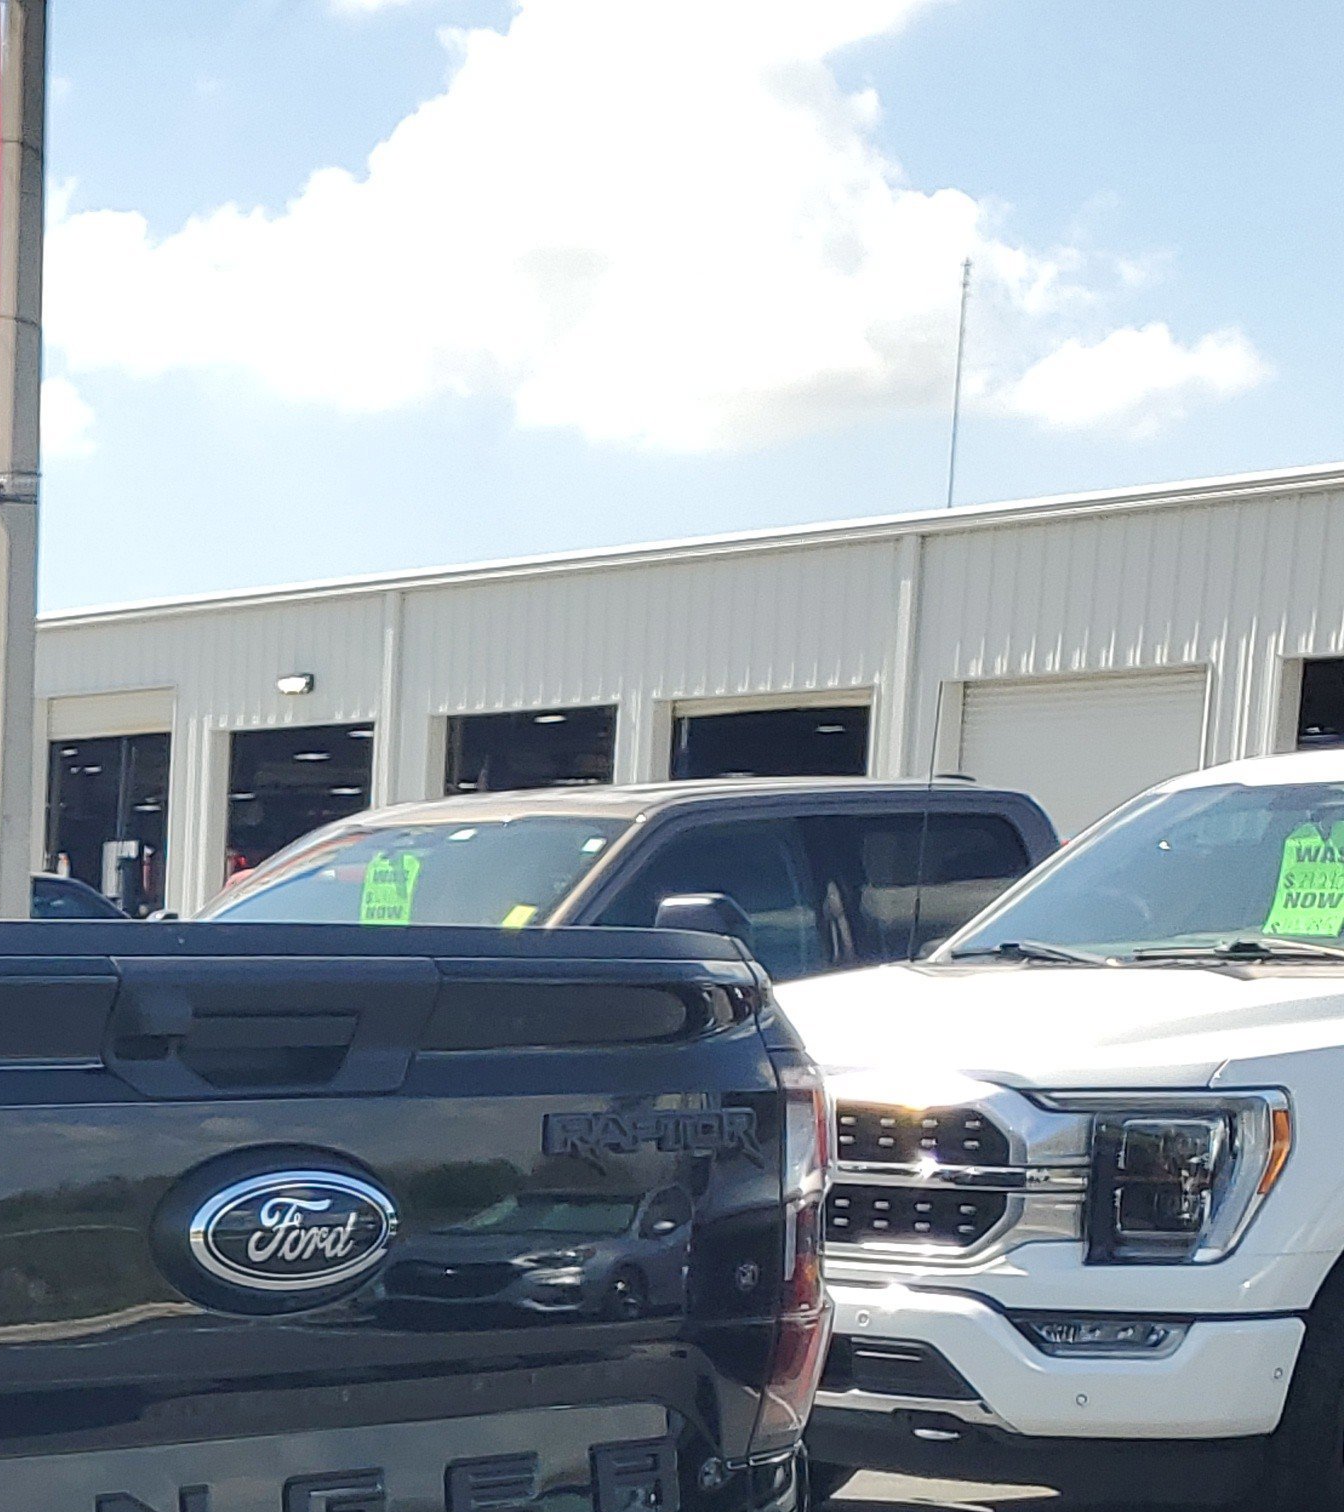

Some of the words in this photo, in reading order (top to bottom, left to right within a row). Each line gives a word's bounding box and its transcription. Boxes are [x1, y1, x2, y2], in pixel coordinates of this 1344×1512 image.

[1283, 892, 1344, 909] NOW
[541, 1107, 765, 1176] RAPTOR
[247, 1196, 358, 1264] Ford
